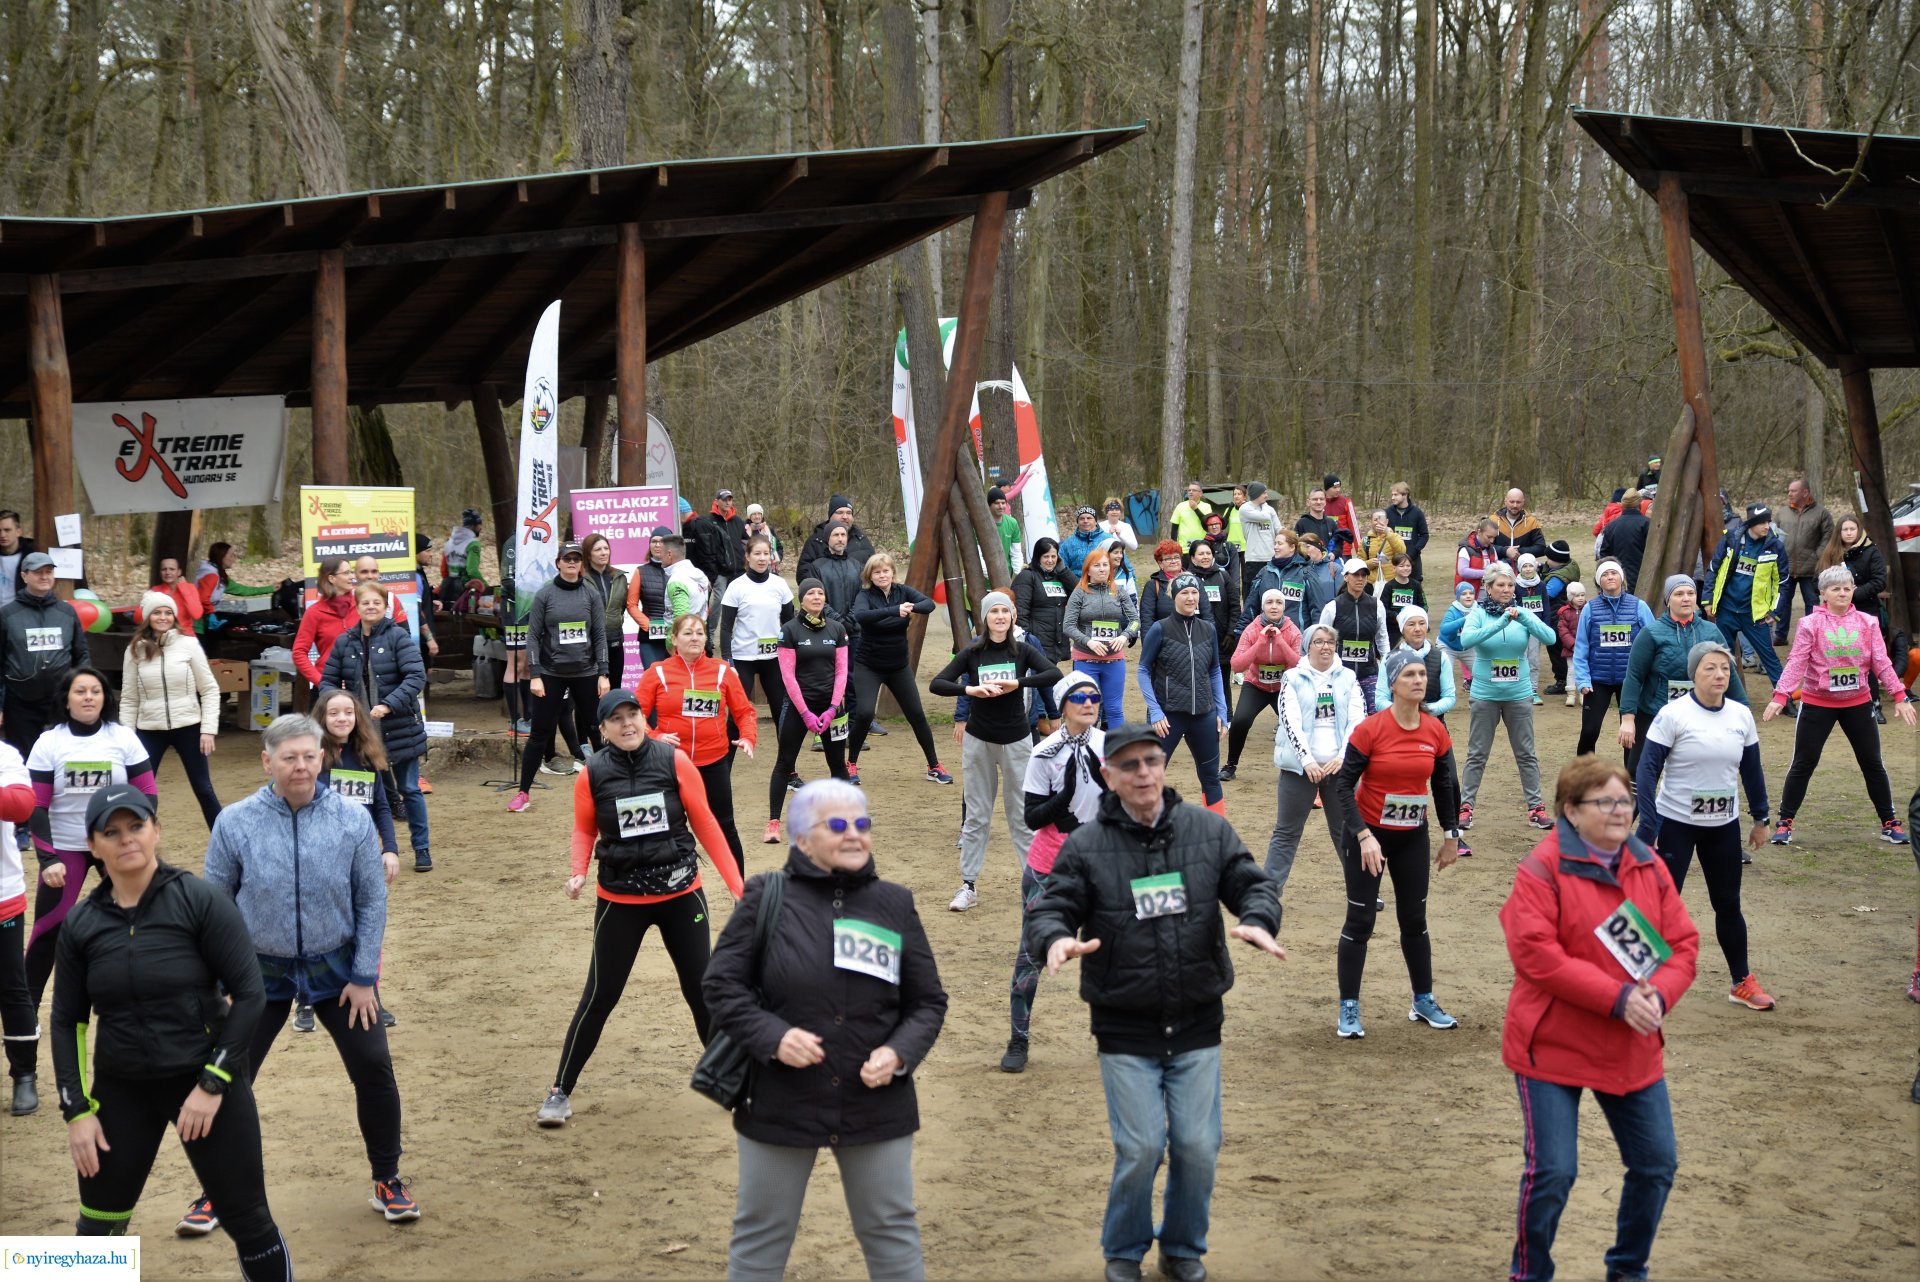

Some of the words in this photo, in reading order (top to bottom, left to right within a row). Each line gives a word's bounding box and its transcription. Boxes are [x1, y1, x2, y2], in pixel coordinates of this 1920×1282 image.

[173, 454, 243, 471] TRAIL
[182, 473, 222, 484] HUNGARY
[225, 472, 237, 482] SE
[576, 496, 669, 511] CSATLAKOZZ
[374, 516, 409, 528] TOKAJ
[588, 510, 659, 525] HOZZÁNK
[331, 527, 367, 536] EXTREME
[592, 526, 625, 540] MÉG
[315, 546, 347, 556] TRAIL
[349, 540, 407, 554] FESZTIVÁL
[1282, 587, 1301, 597] 006
[1395, 595, 1411, 604] 068
[1524, 600, 1541, 609] 066
[560, 628, 583, 639] 134
[1094, 627, 1113, 637] 153
[1602, 631, 1626, 642] 150
[29, 634, 56, 646] 210
[759, 644, 778, 654] 159
[1345, 646, 1366, 657] 149
[1260, 670, 1280, 680] 154
[1494, 666, 1517, 677] 106
[1832, 673, 1857, 686] 105
[1671, 687, 1688, 699] 22
[685, 698, 713, 712] 124
[67, 770, 103, 787] 117
[333, 779, 366, 797] 118
[1384, 803, 1420, 819] 218
[1693, 797, 1728, 813] 219
[620, 805, 663, 828] 229
[671, 865, 688, 880] NIKE
[1139, 888, 1185, 915] 025
[1608, 915, 1652, 966] 023
[839, 934, 889, 968] 026
